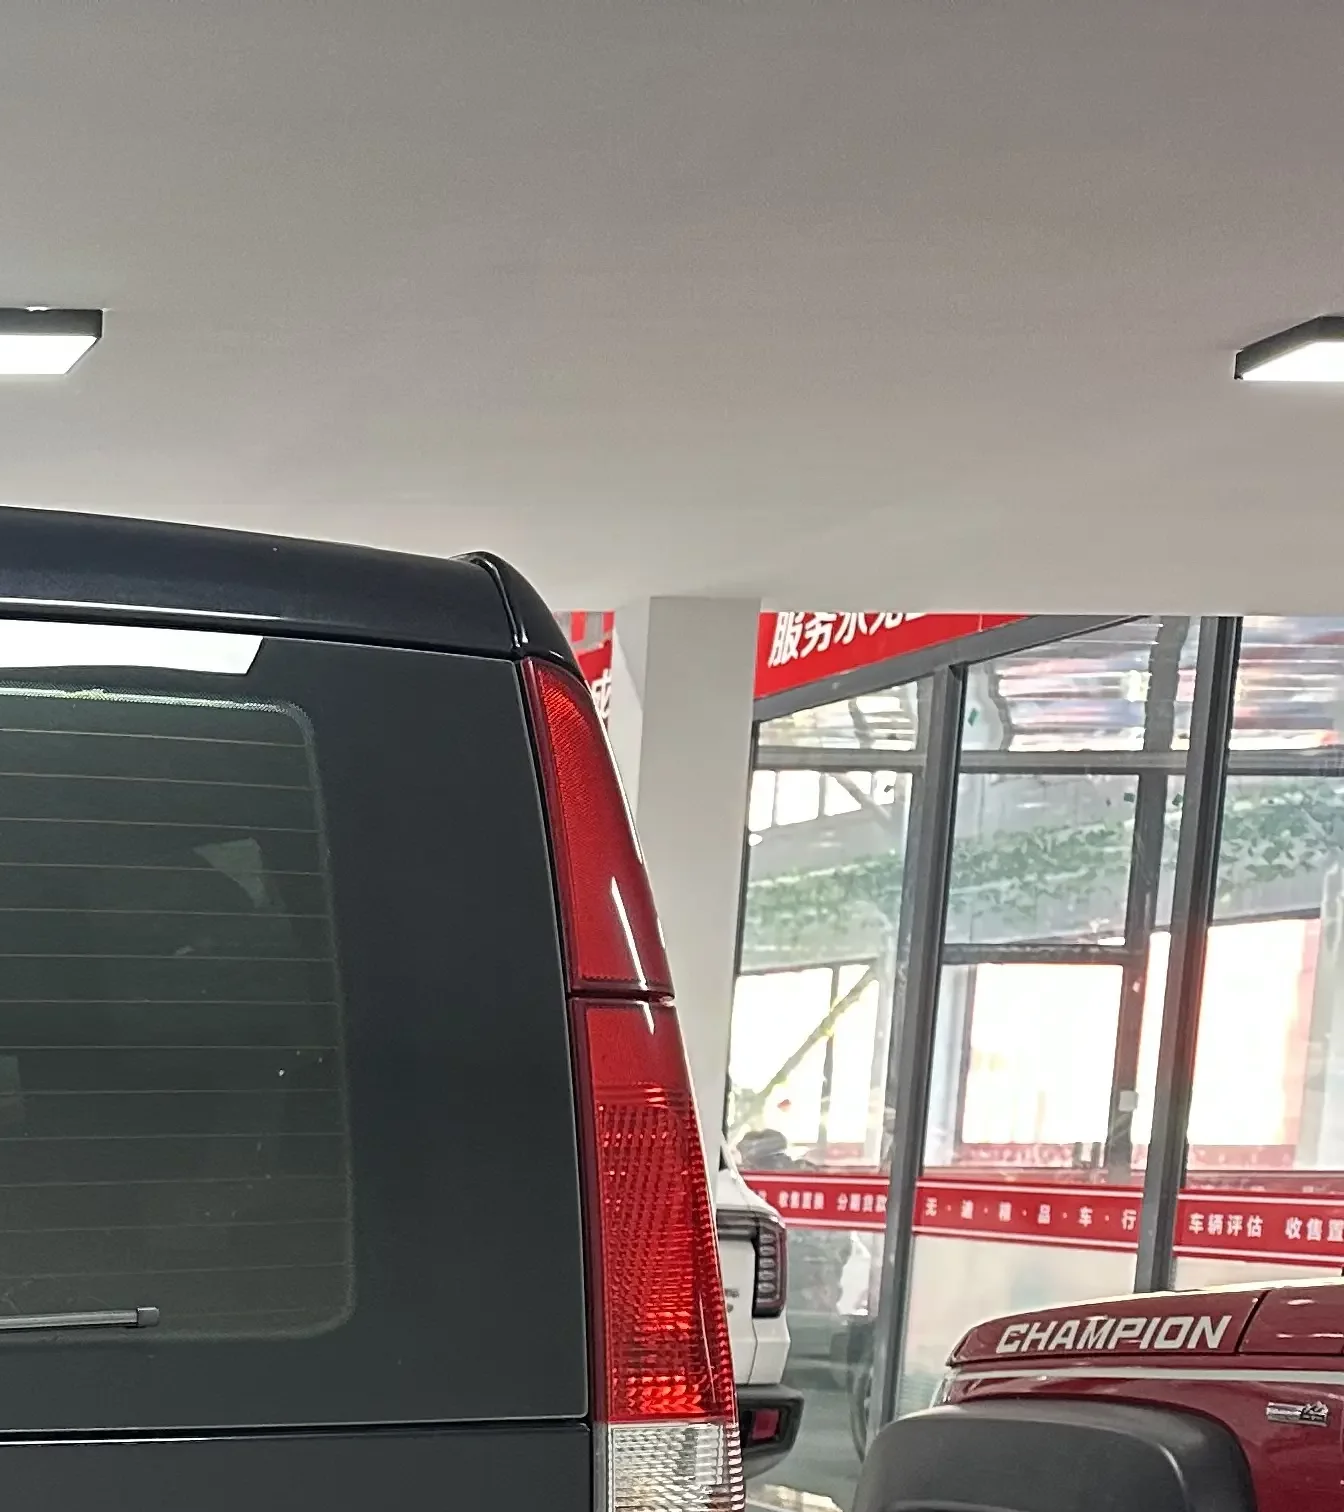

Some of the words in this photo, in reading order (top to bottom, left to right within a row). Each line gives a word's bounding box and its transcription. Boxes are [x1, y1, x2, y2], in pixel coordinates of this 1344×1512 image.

[1188, 1212, 1264, 1238] 车辆评估
[995, 1315, 1233, 1354] CHAMPION
